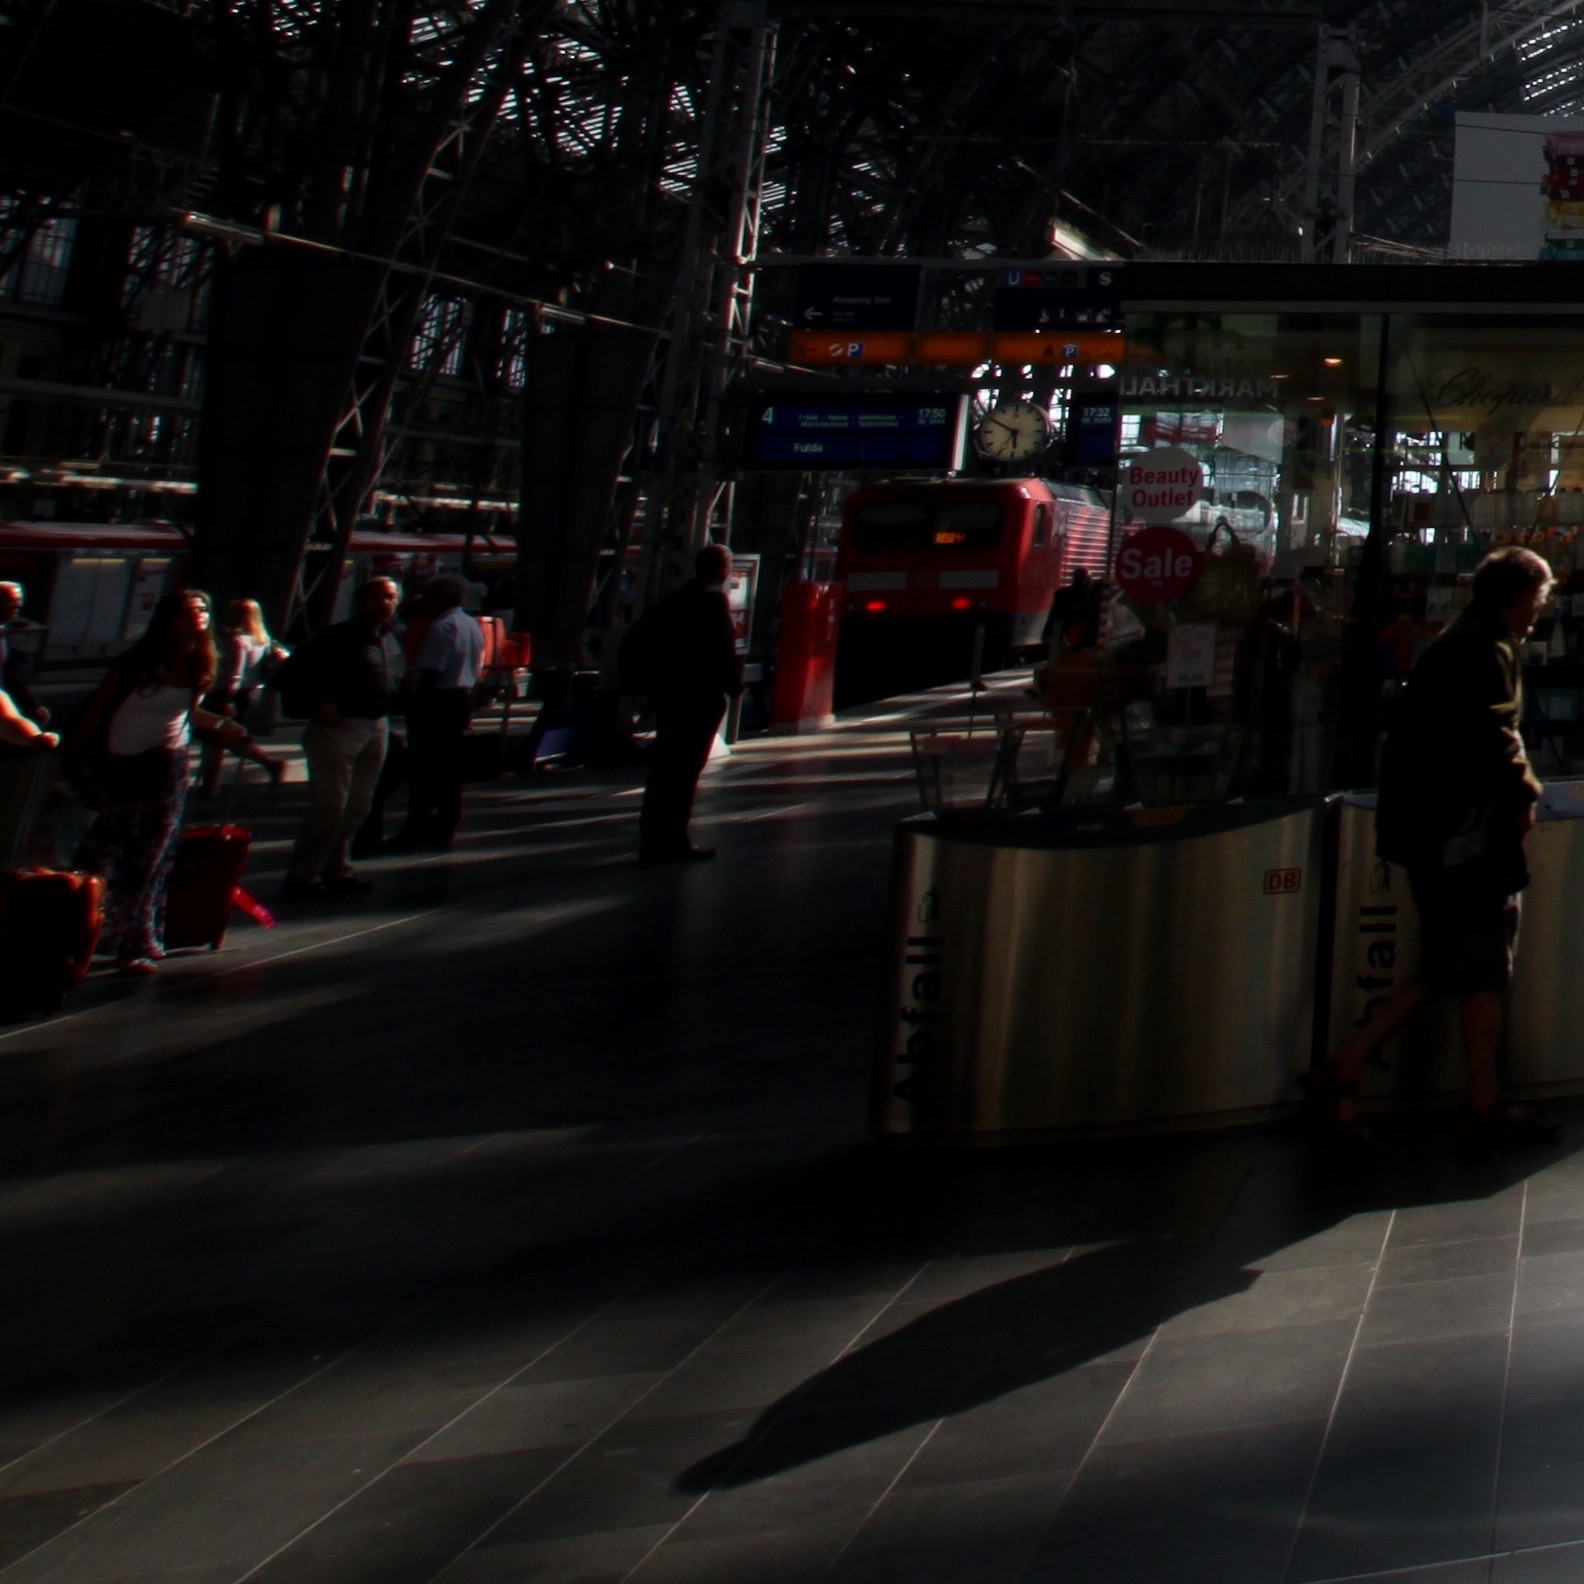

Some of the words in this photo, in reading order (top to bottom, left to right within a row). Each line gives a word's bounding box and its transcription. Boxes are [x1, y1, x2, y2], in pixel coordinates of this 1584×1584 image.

[1099, 272, 1112, 286] S
[847, 343, 860, 357] P
[760, 406, 774, 425] 4
[1130, 466, 1199, 487] Beauty
[1132, 489, 1194, 508] Outlet
[1120, 546, 1193, 580] Sale
[1266, 871, 1299, 892] DB
[1354, 905, 1397, 1071] fall
[894, 936, 944, 1104] Abfall
